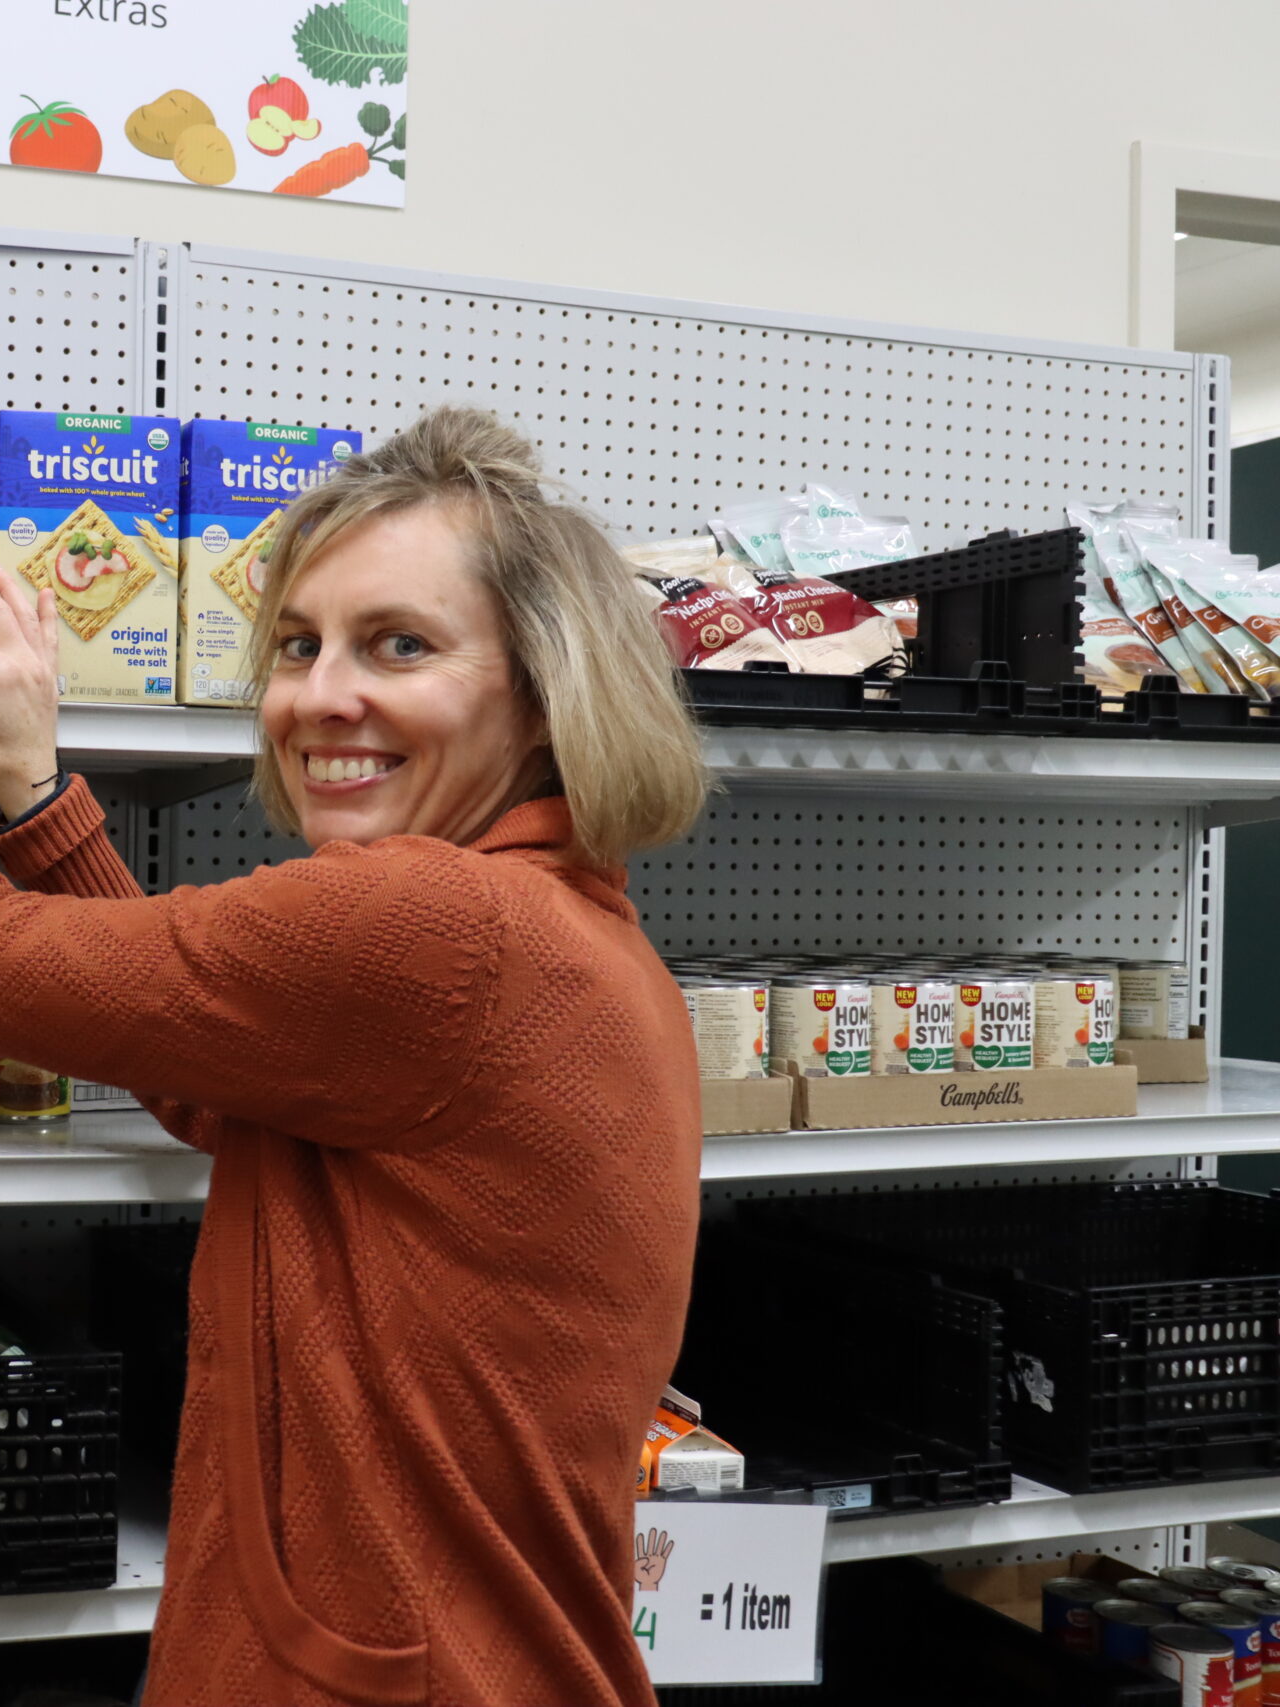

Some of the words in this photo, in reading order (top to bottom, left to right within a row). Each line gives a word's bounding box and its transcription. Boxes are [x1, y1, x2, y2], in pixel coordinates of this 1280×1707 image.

[65, 417, 122, 429] ORGANIC
[255, 427, 308, 441] ORGANIC
[28, 446, 158, 485] triscuit
[11, 527, 35, 535] quality
[204, 535, 227, 543] quality
[771, 590, 804, 602] Nacho
[678, 597, 715, 620] Nacho
[689, 607, 722, 629] INSTANT
[111, 627, 168, 644] original
[113, 646, 141, 656] made
[144, 647, 167, 656] with
[128, 658, 145, 667] sea
[148, 658, 167, 667] salt
[815, 992, 835, 1001] NEW
[896, 990, 915, 999] NEW
[962, 988, 980, 997] NEW
[1077, 986, 1094, 995] NEW
[835, 1006, 870, 1026] HOM
[981, 1002, 1031, 1021] HOME
[834, 1029, 870, 1048] STYL
[980, 1024, 1031, 1042] STYLE
[940, 1082, 1019, 1110] Campbell's
[701, 1594, 714, 1620] =
[722, 1582, 733, 1630] 1
[741, 1583, 791, 1631] item
[632, 1606, 657, 1651] 4
